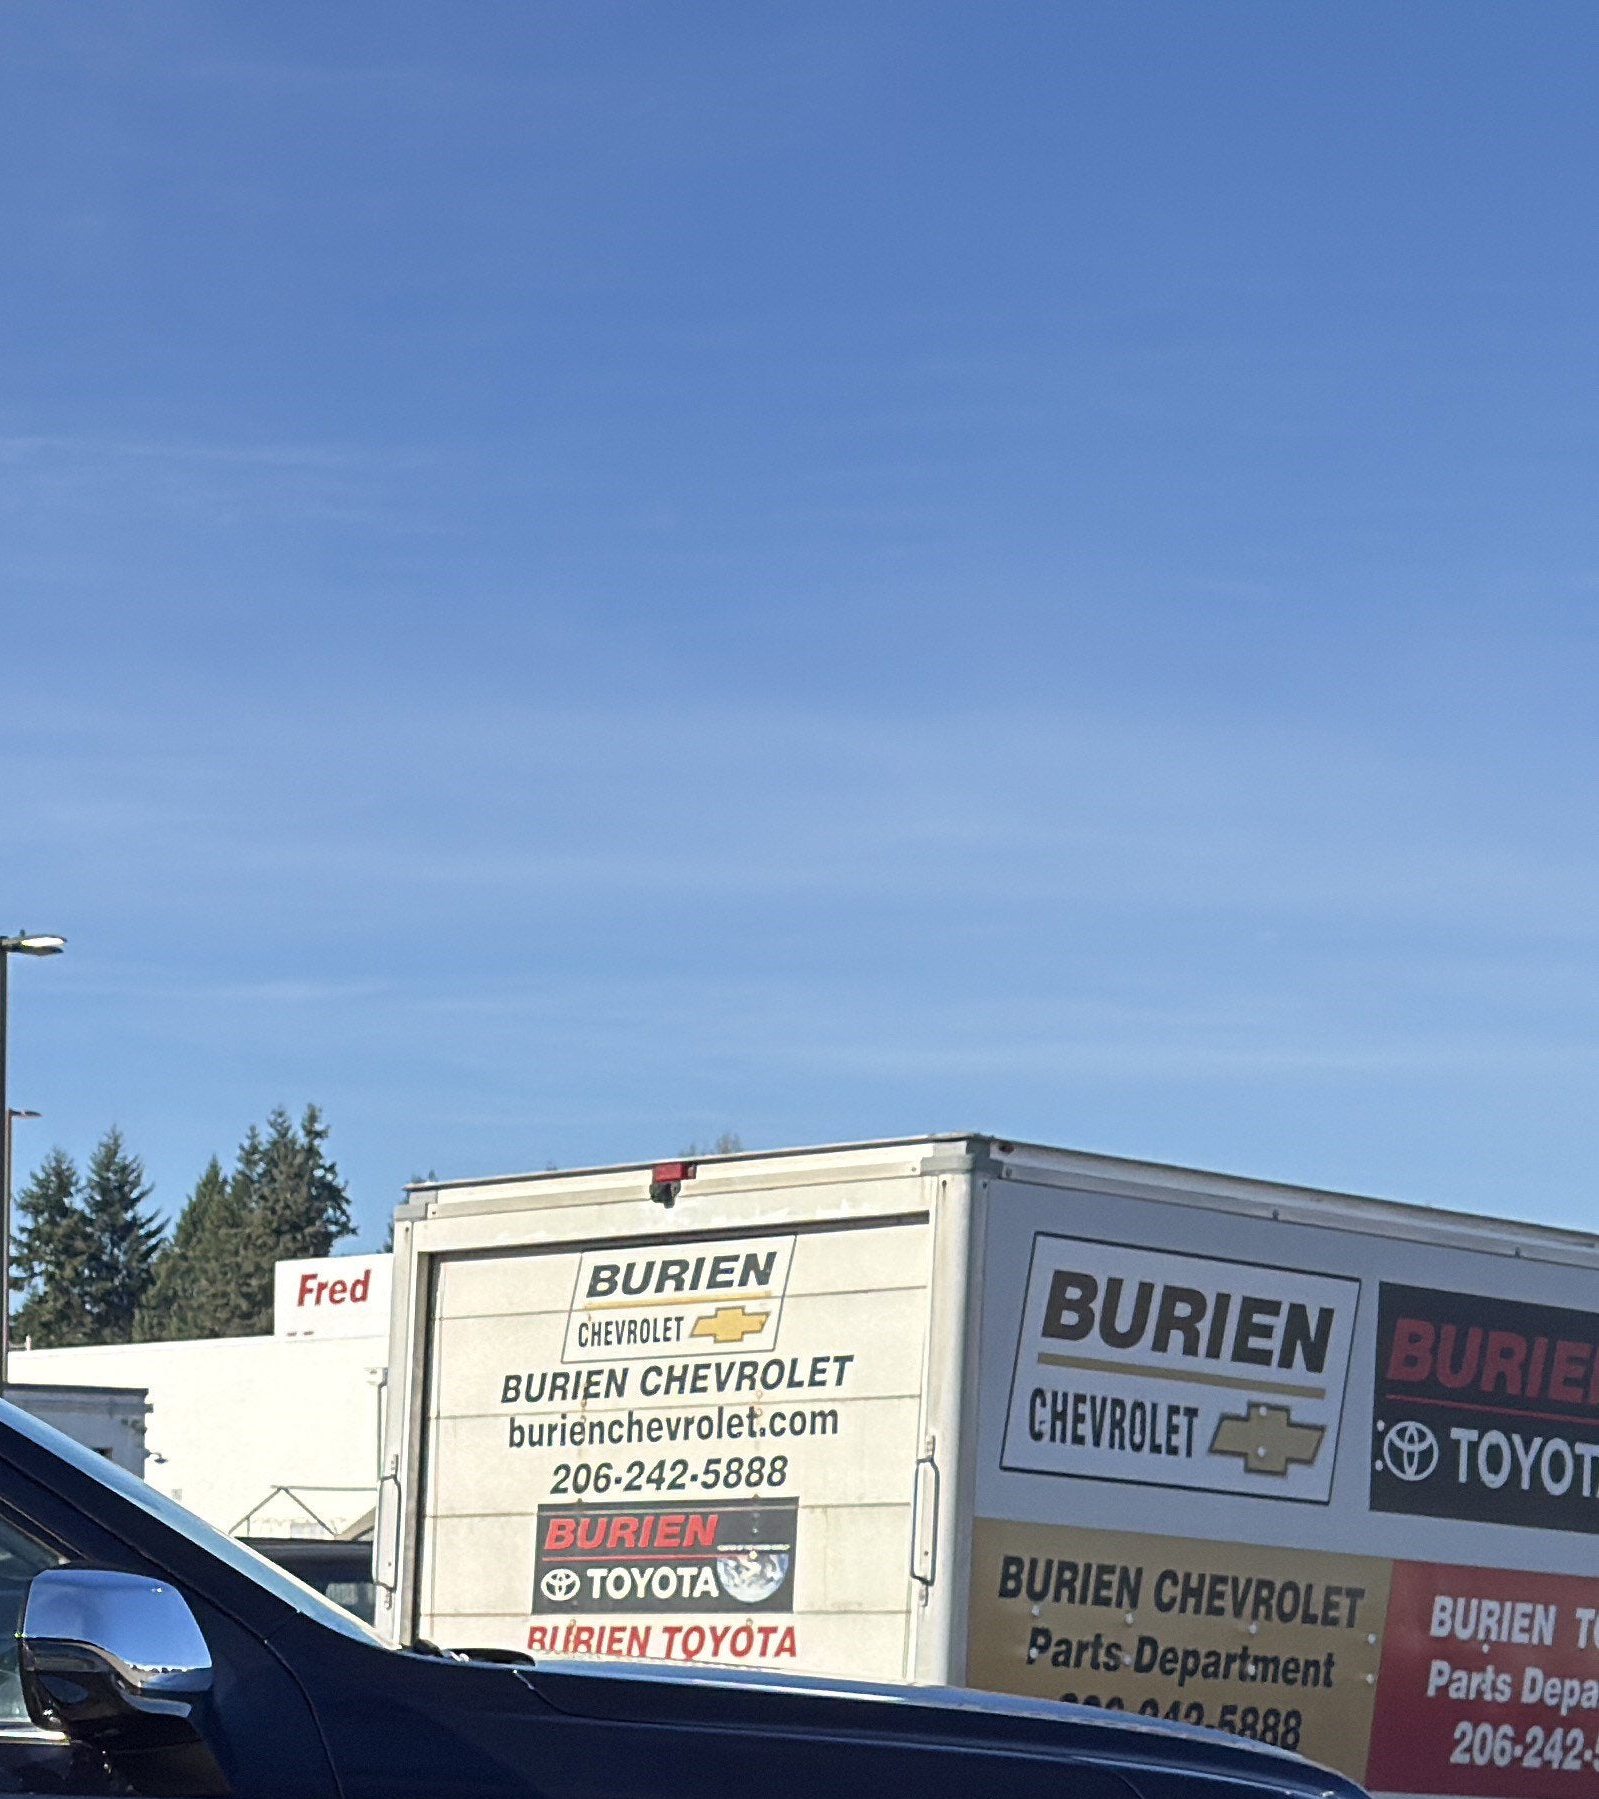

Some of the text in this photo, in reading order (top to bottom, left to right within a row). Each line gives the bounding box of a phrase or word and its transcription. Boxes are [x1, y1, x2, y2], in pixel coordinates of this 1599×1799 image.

[297, 1268, 372, 1307] Fred
[586, 1251, 778, 1298] BURIEN
[577, 1316, 684, 1348] CHEVROLET
[1041, 1269, 1335, 1374] BURIEN
[501, 1354, 855, 1403] BURIEN CHEVROLET
[1387, 1317, 1599, 1405] BURIE
[508, 1406, 839, 1448] burienchevrolet.com
[1028, 1387, 1199, 1459] CHEVROLET
[1450, 1427, 1599, 1499] TOYOT
[544, 1514, 719, 1551] BURIEN
[587, 1566, 720, 1599] TOYOTA
[998, 1556, 1365, 1628] BURIEN CHEVROLET
[527, 1625, 797, 1661] BURIEN TOYOTA
[1430, 1595, 1599, 1649] BURIEN T
[1026, 1627, 1335, 1687] Parts Department
[1427, 1659, 1512, 1703] Parts
